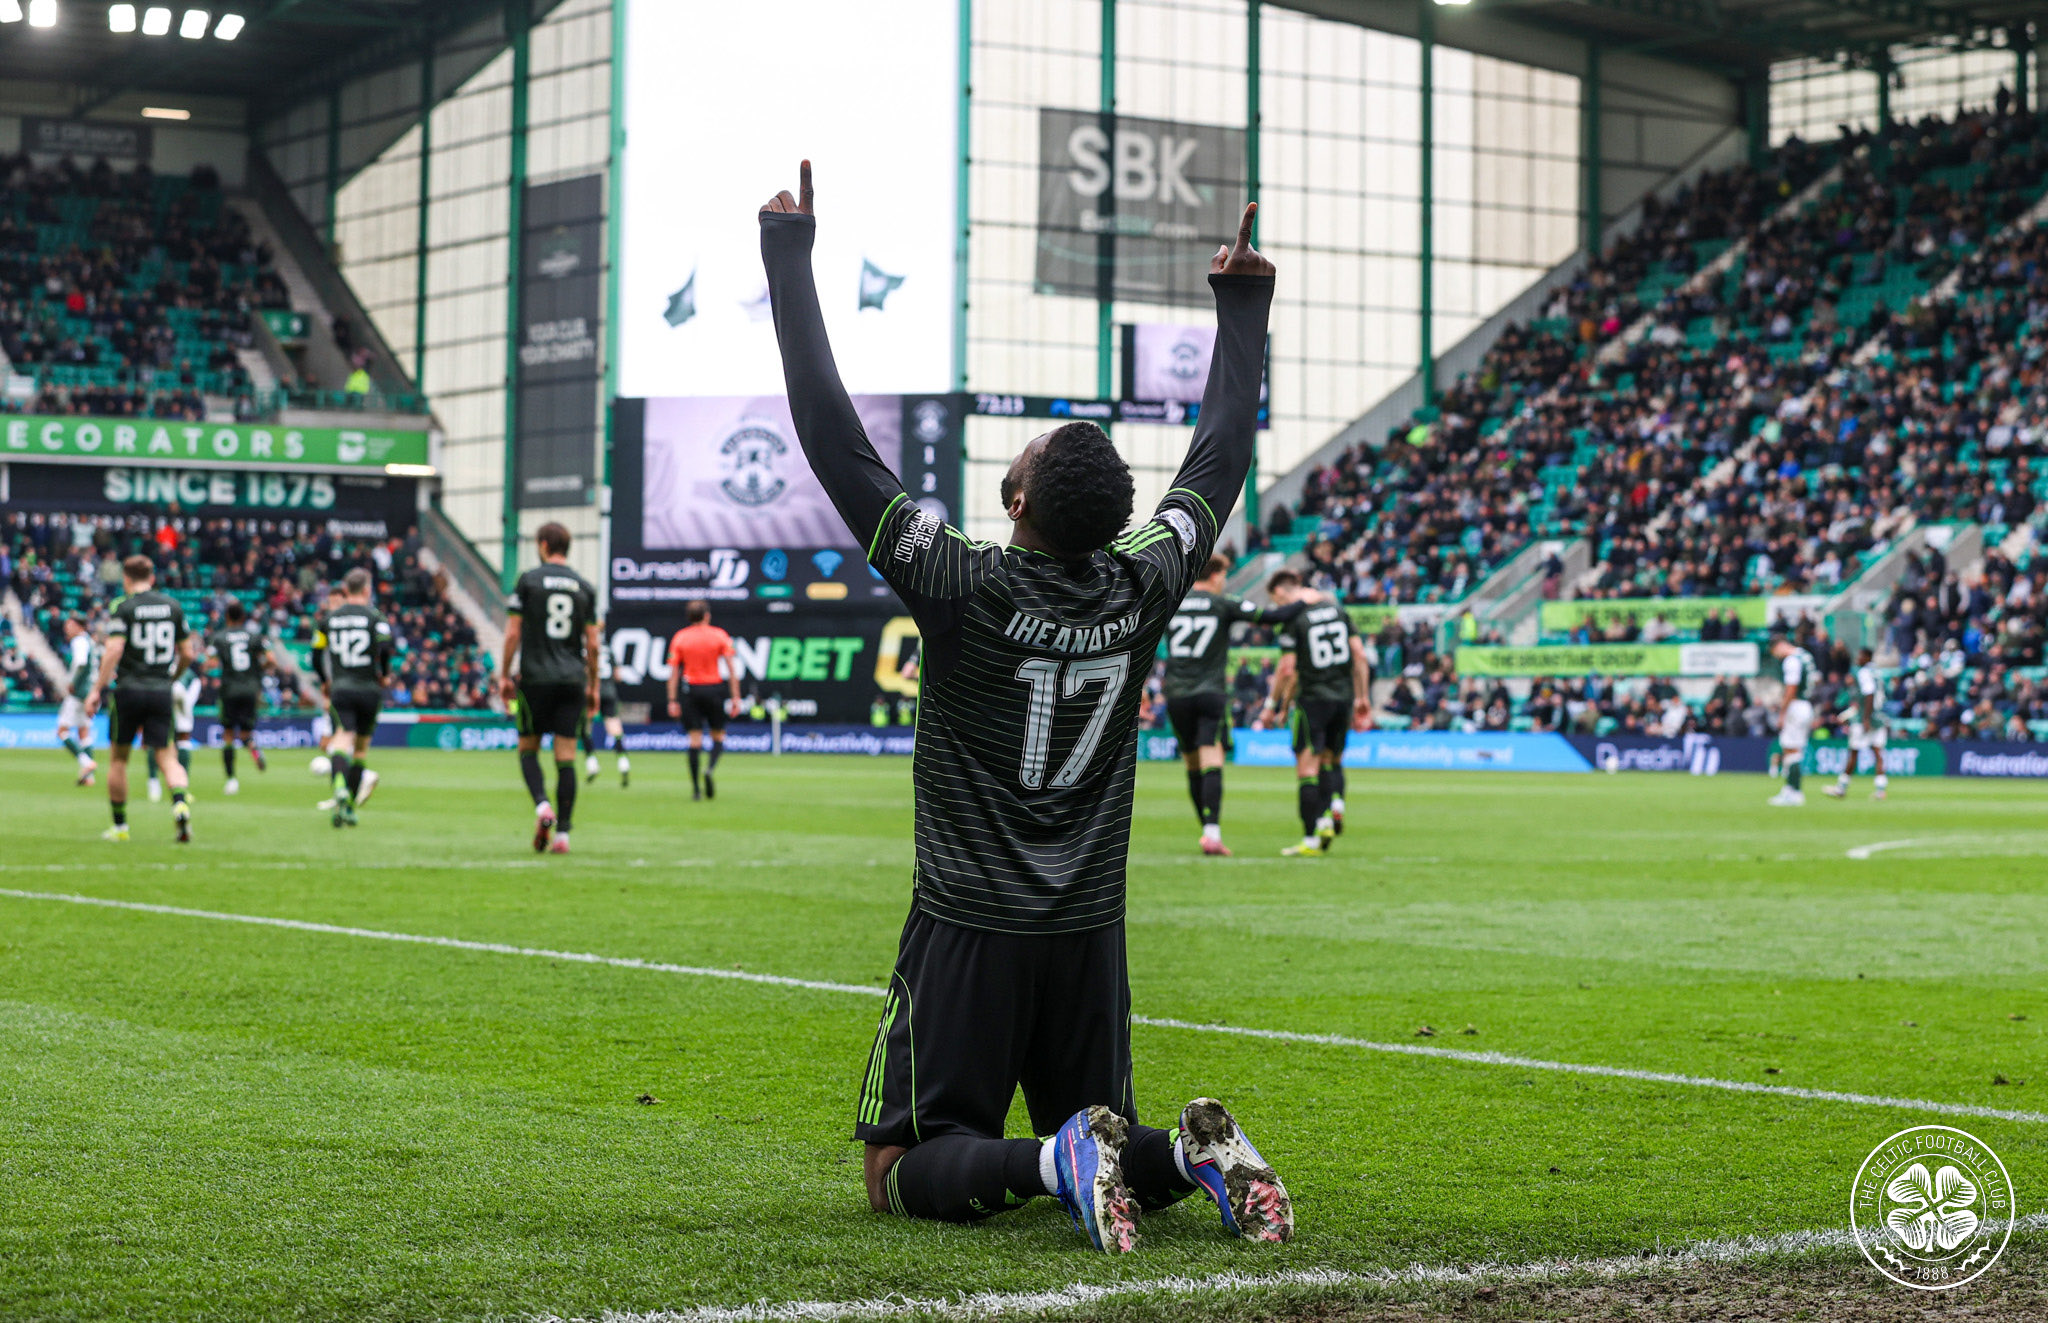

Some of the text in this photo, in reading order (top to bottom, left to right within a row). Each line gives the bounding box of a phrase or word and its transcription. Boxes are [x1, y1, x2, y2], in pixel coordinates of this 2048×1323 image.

[1067, 125, 1201, 207] SBK
[7, 420, 305, 459] ECORATORS
[103, 466, 336, 509] SINCE 1875
[612, 557, 711, 581] Dunedin
[545, 594, 574, 640] 8
[1004, 610, 1143, 655] IHEANACHO
[1168, 615, 1218, 658] 27
[130, 620, 176, 665] 49
[230, 643, 250, 672] 6
[329, 629, 372, 668] 42
[611, 628, 864, 685] QUNBET
[1308, 620, 1351, 668] 63
[1014, 651, 1131, 790] 17
